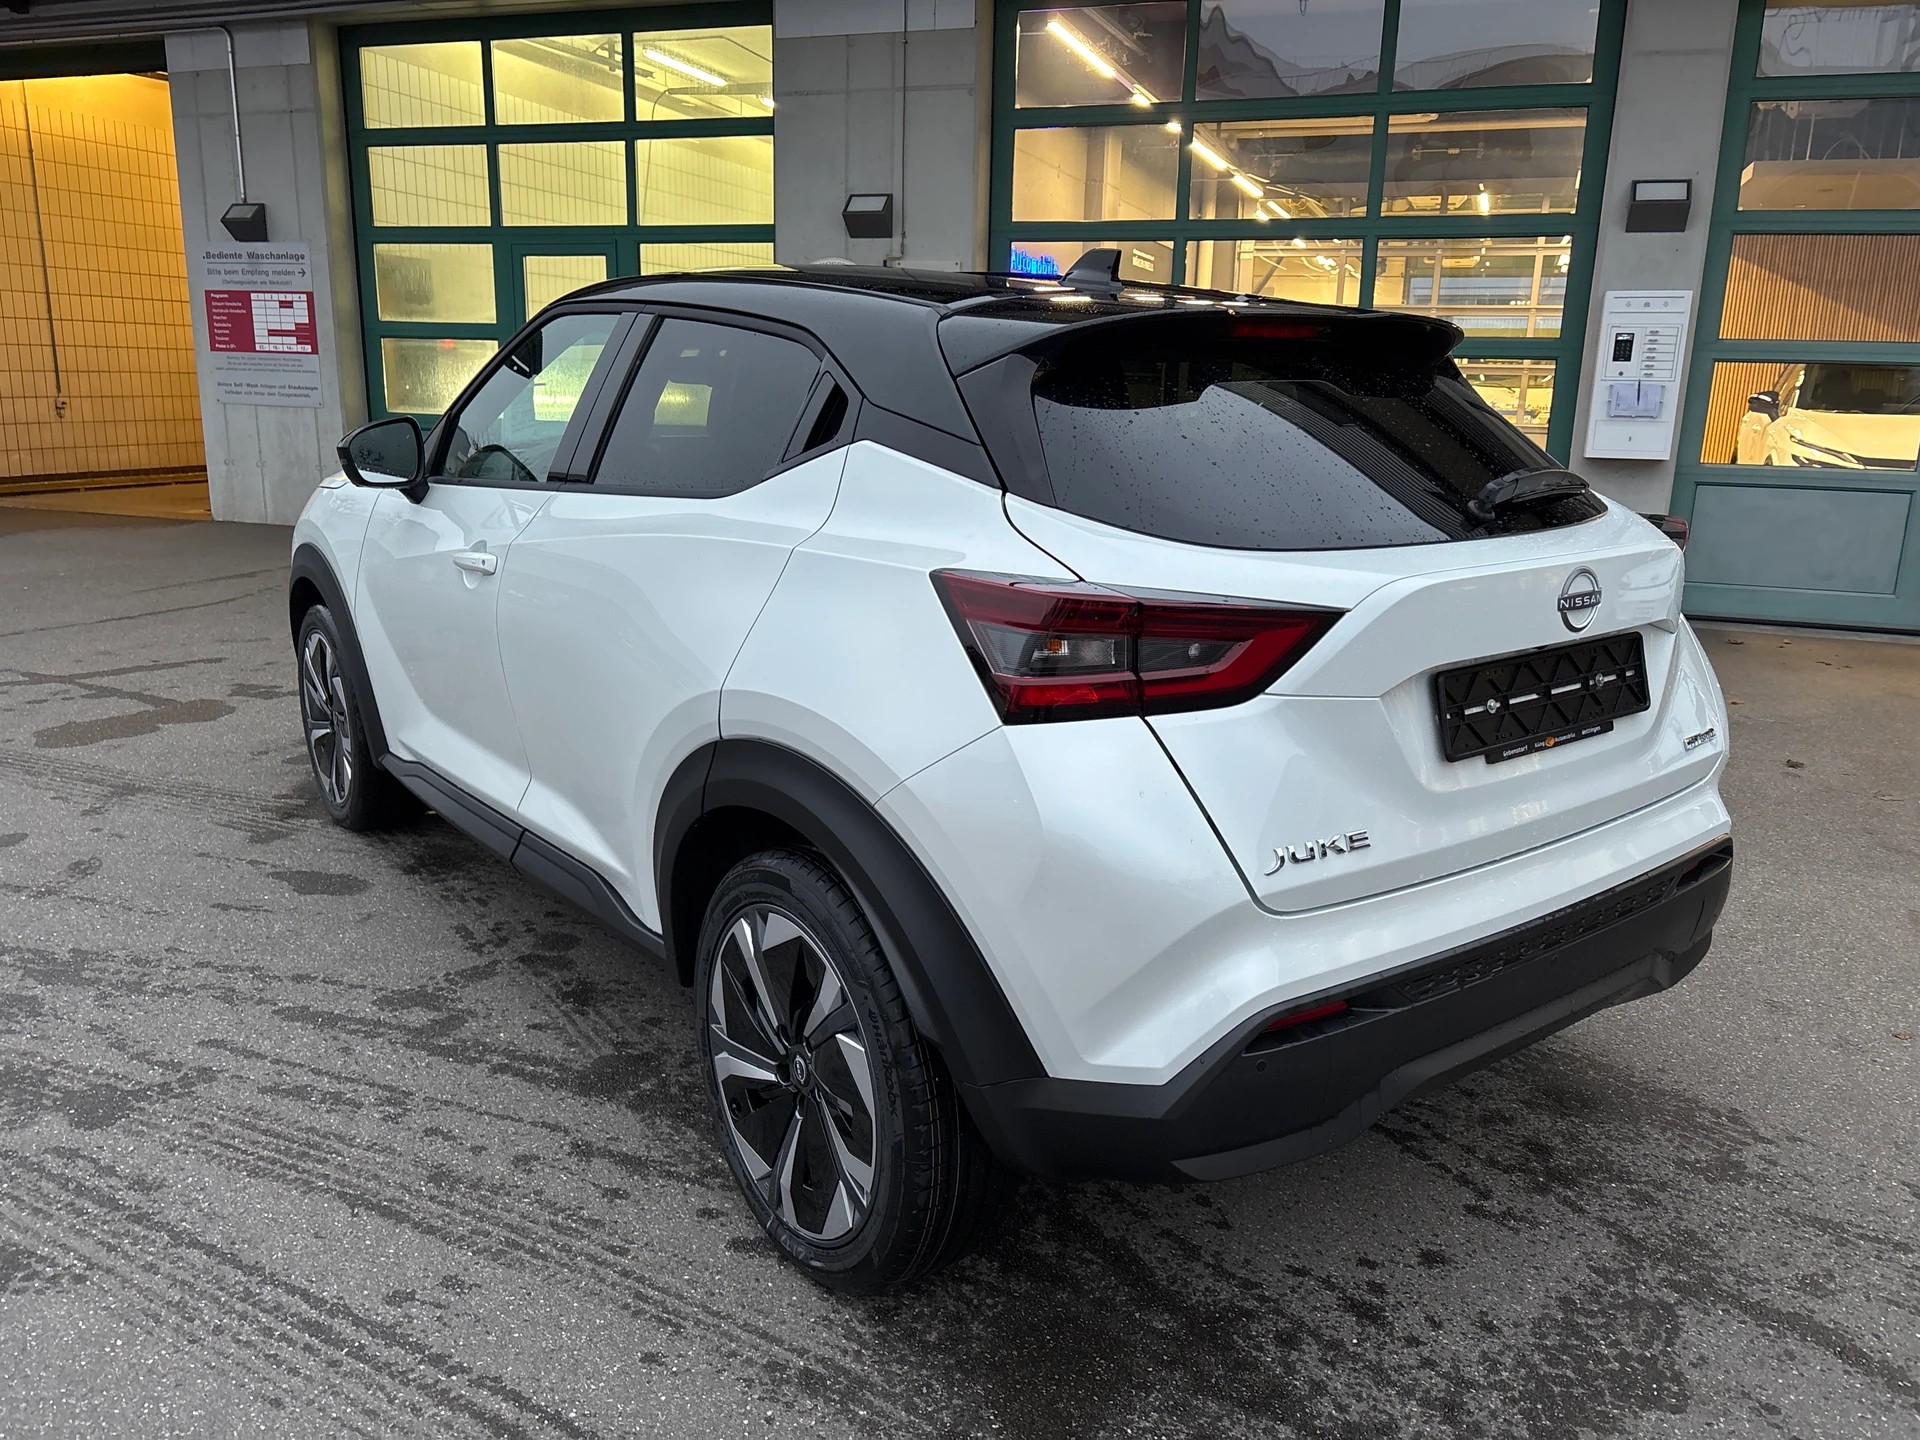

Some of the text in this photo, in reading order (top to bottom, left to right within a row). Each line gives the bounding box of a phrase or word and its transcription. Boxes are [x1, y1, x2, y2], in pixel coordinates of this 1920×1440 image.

[205, 251, 305, 262] Bediente Waschanlage
[207, 268, 296, 278] Bitte beim Empfang melden
[1559, 594, 1601, 609] NISSAN
[1502, 744, 1528, 757] Gebenstorf
[1264, 828, 1372, 877] JUKE
